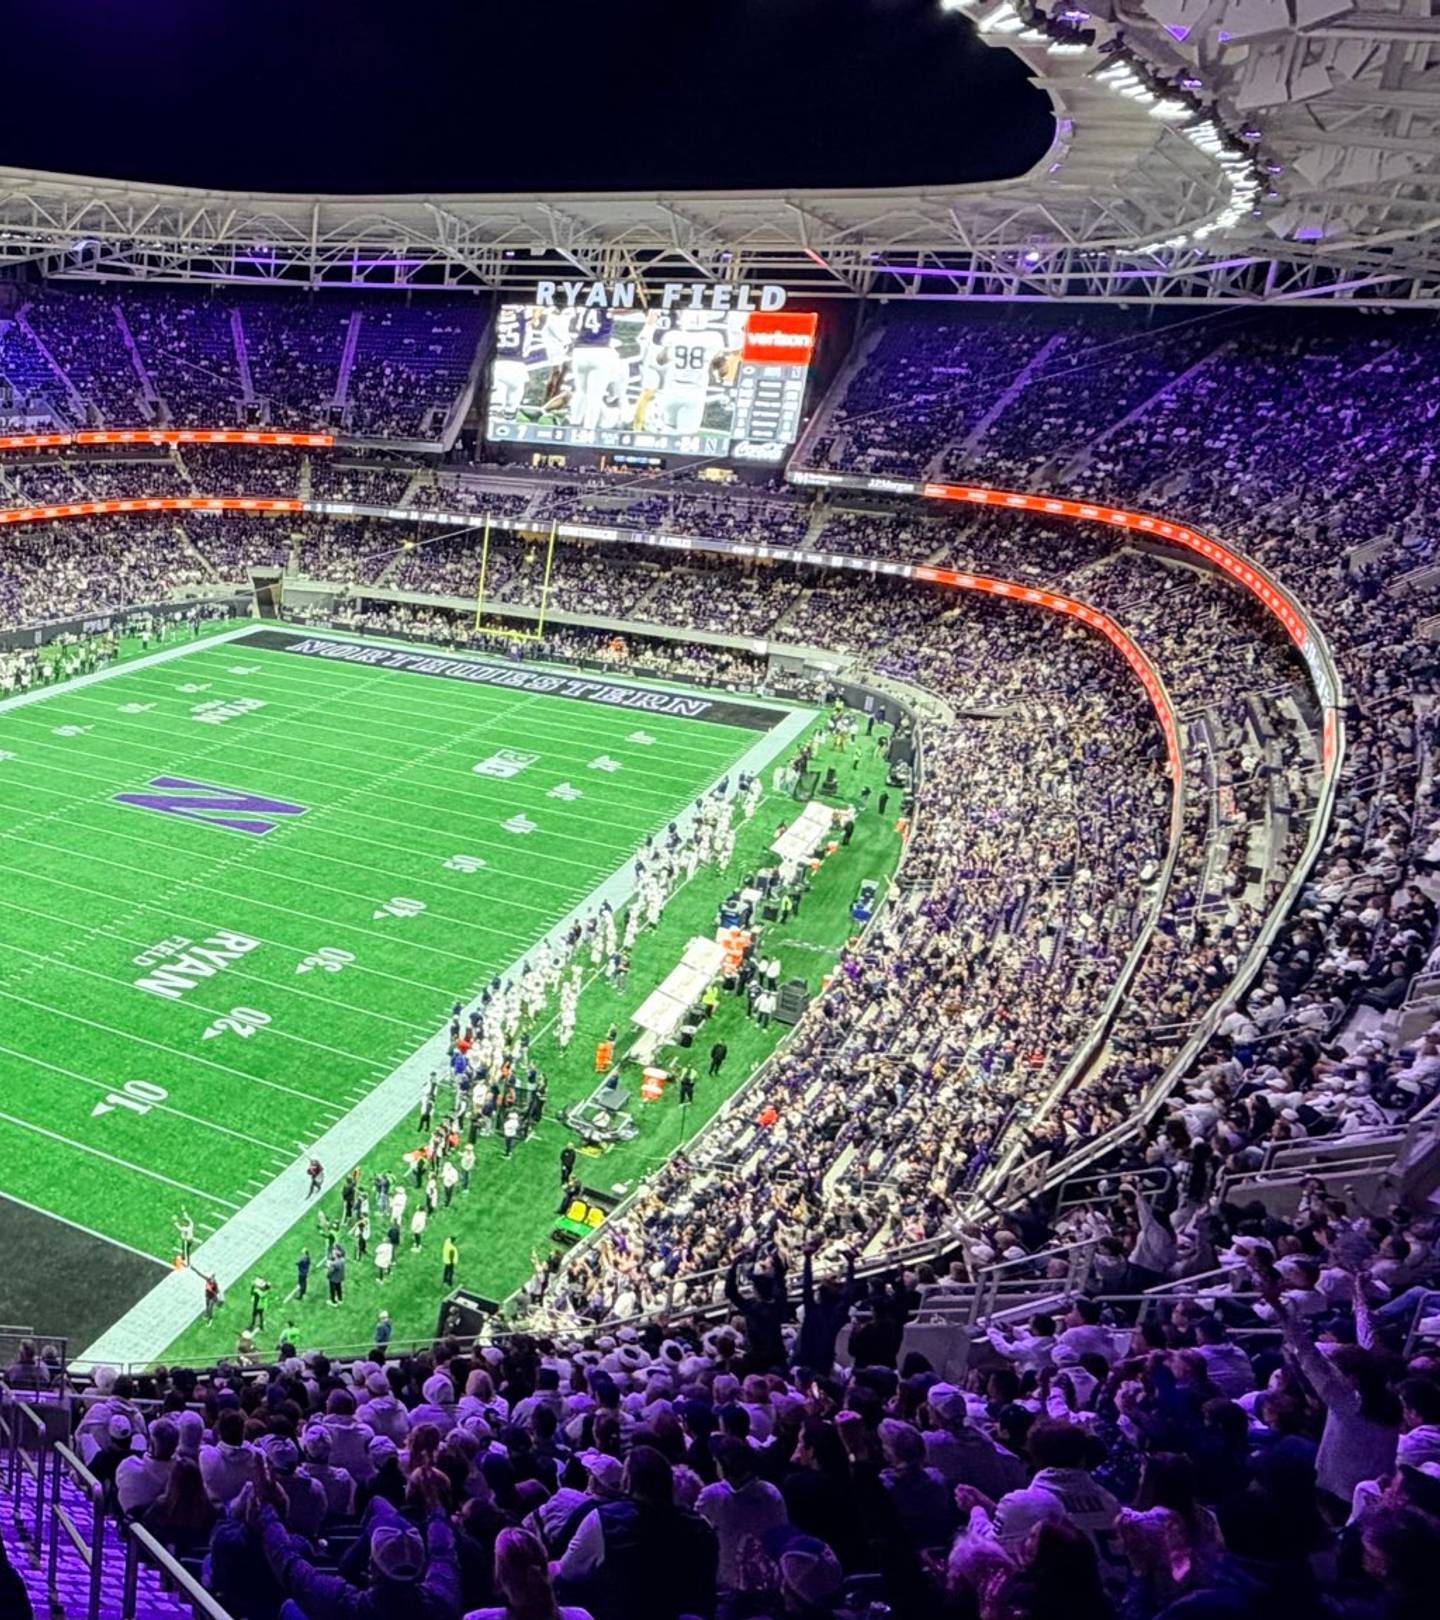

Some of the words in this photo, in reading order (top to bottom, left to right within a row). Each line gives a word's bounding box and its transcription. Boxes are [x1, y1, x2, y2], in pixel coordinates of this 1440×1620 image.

[536, 281, 636, 307] RYAN
[661, 283, 787, 311] FIELD
[747, 331, 811, 348] verizon
[673, 345, 705, 370] 98
[289, 638, 713, 717] NORTHWESTERN
[108, 774, 312, 837] N
[382, 897, 427, 918] 40
[133, 930, 261, 998] RYAN
[303, 947, 356, 972] 30
[212, 1007, 273, 1039] 20
[107, 1079, 169, 1116] 10
